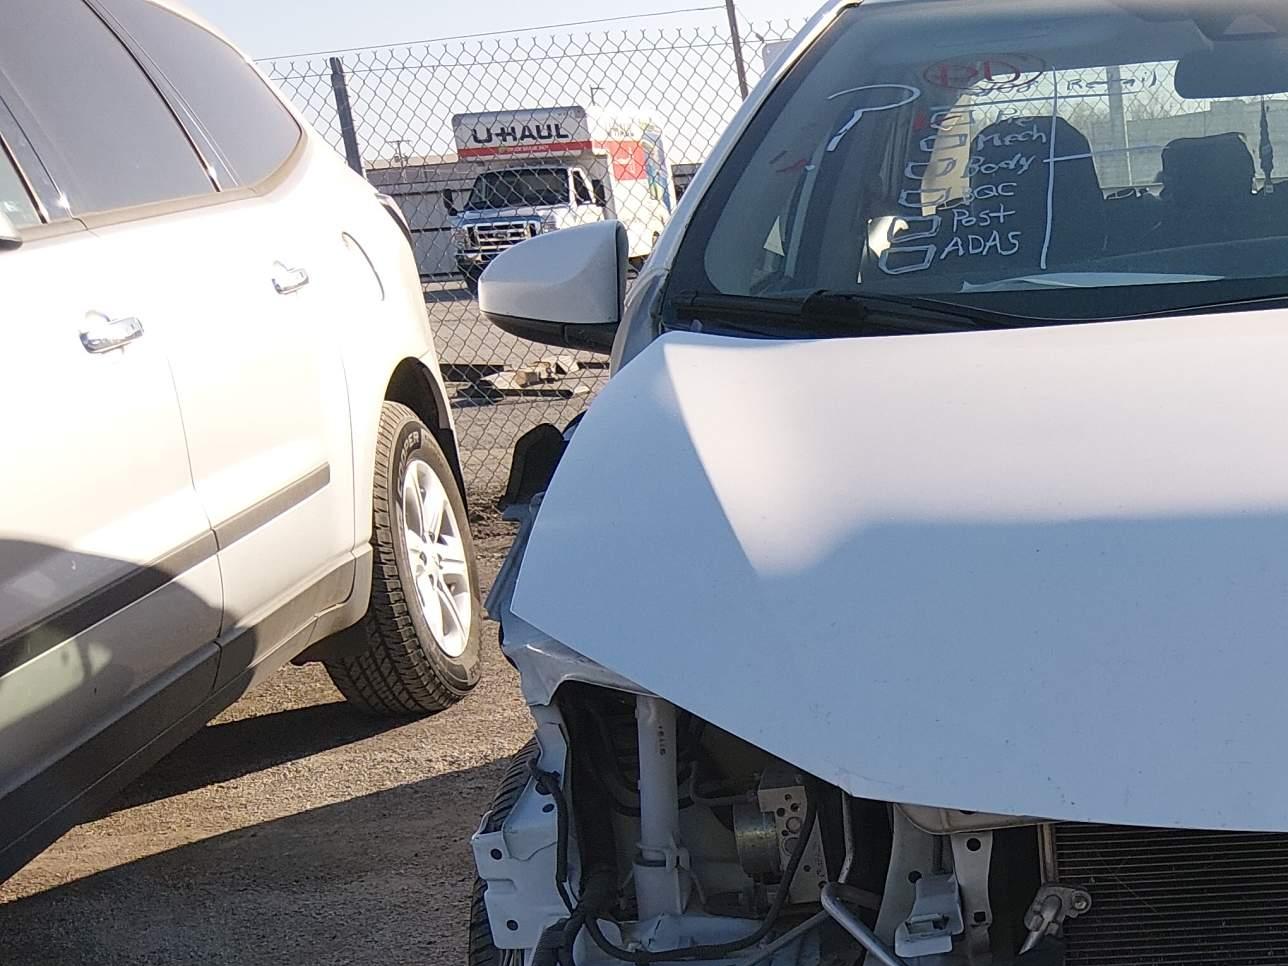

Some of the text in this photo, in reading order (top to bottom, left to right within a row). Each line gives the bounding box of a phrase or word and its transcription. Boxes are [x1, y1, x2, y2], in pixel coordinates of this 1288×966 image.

[472, 123, 570, 144] U-HAUL
[960, 153, 1036, 179] Body
[939, 230, 1022, 260] ADAS
